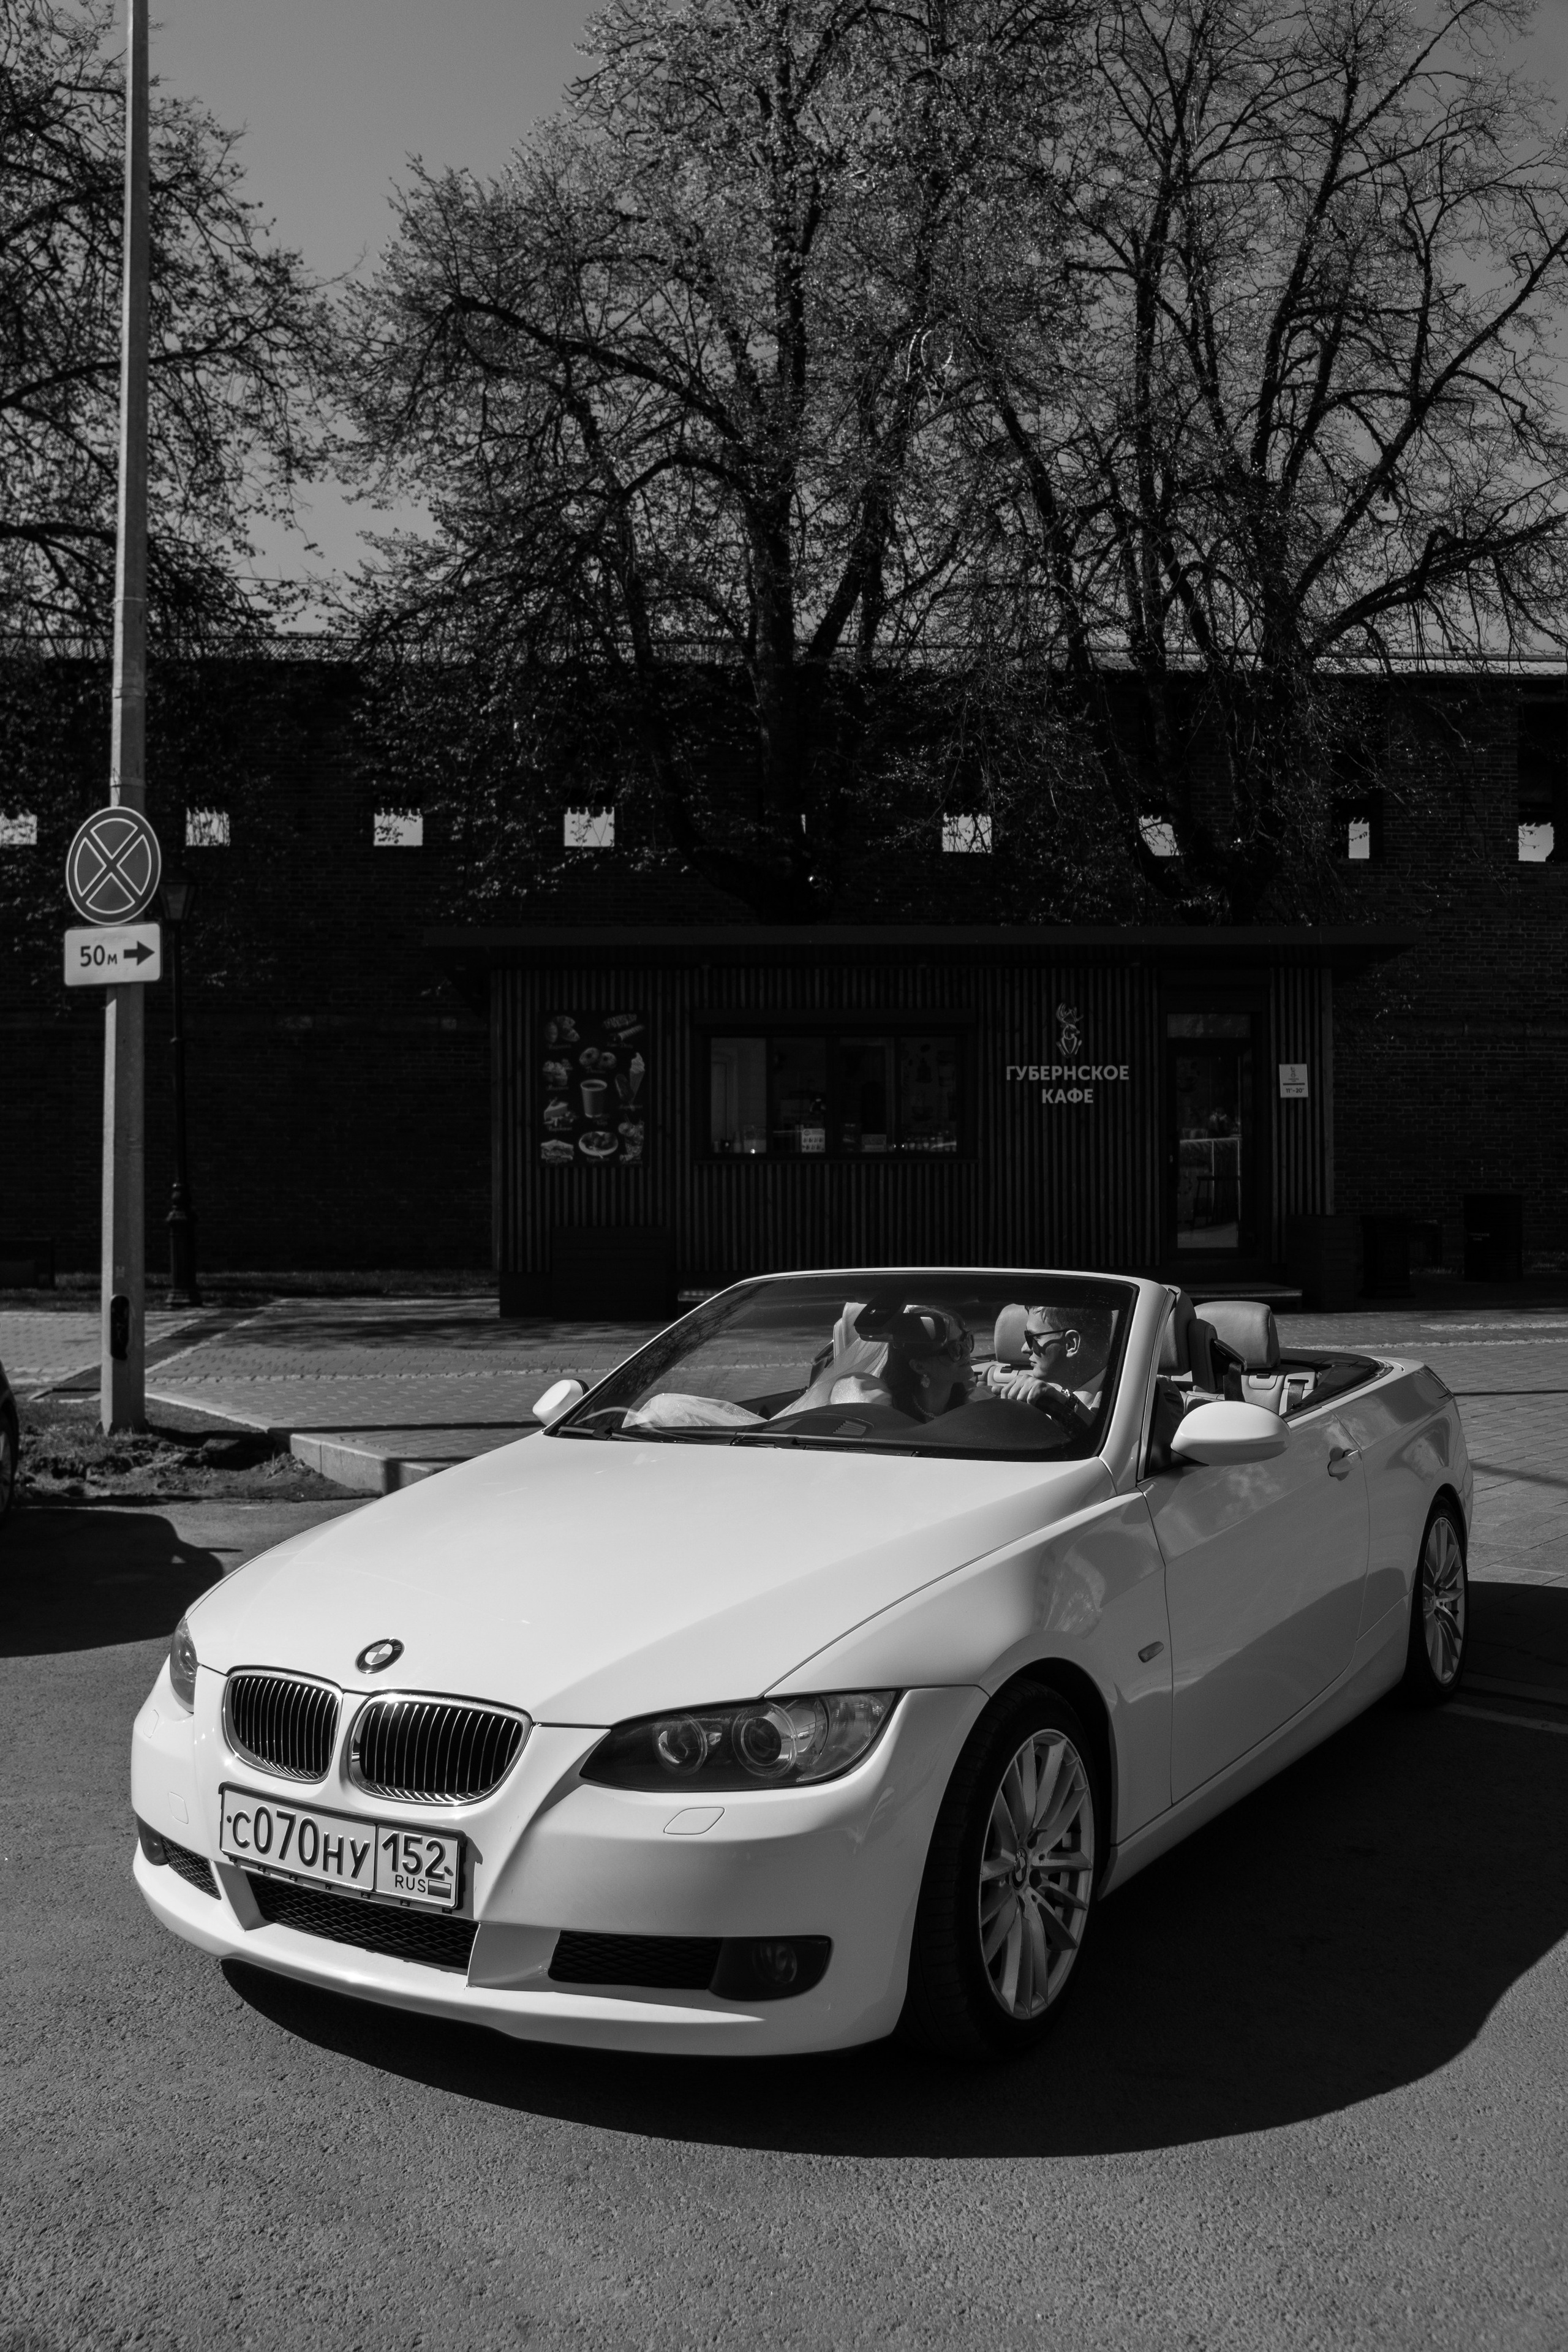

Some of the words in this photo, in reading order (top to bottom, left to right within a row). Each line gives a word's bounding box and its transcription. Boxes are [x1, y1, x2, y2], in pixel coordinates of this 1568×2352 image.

[1006, 1065, 1129, 1081] ГУБЕРНСКОЕ
[1042, 1087, 1094, 1104] КАФЕ
[381, 1831, 447, 1880] 152
[394, 1874, 426, 1893] RUS
